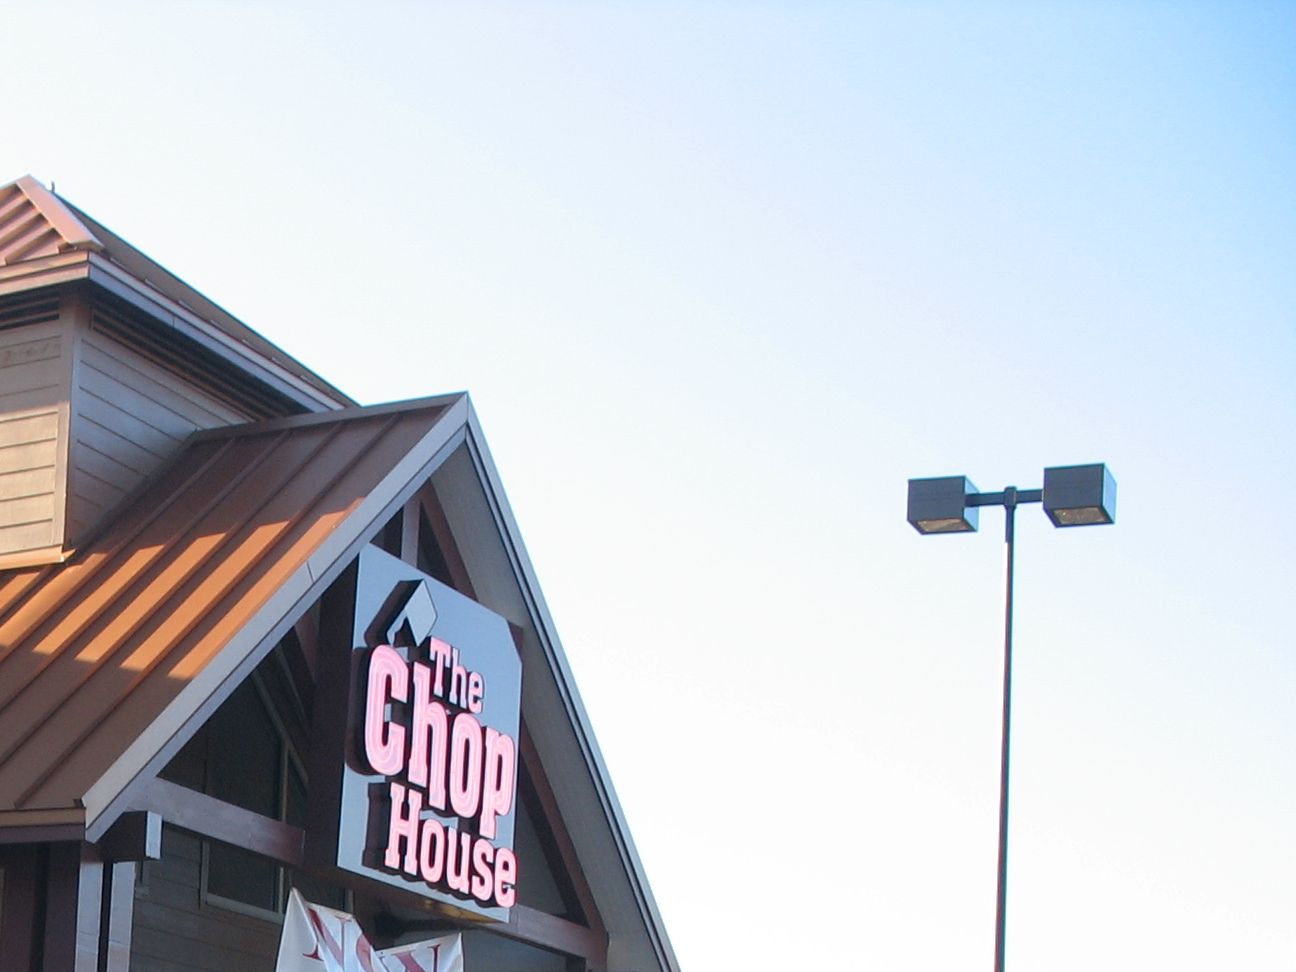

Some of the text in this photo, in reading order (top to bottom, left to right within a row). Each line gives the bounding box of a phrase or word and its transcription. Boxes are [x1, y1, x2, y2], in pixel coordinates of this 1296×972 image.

[429, 635, 486, 714] The
[364, 644, 516, 840] Chop
[384, 781, 518, 908] House
